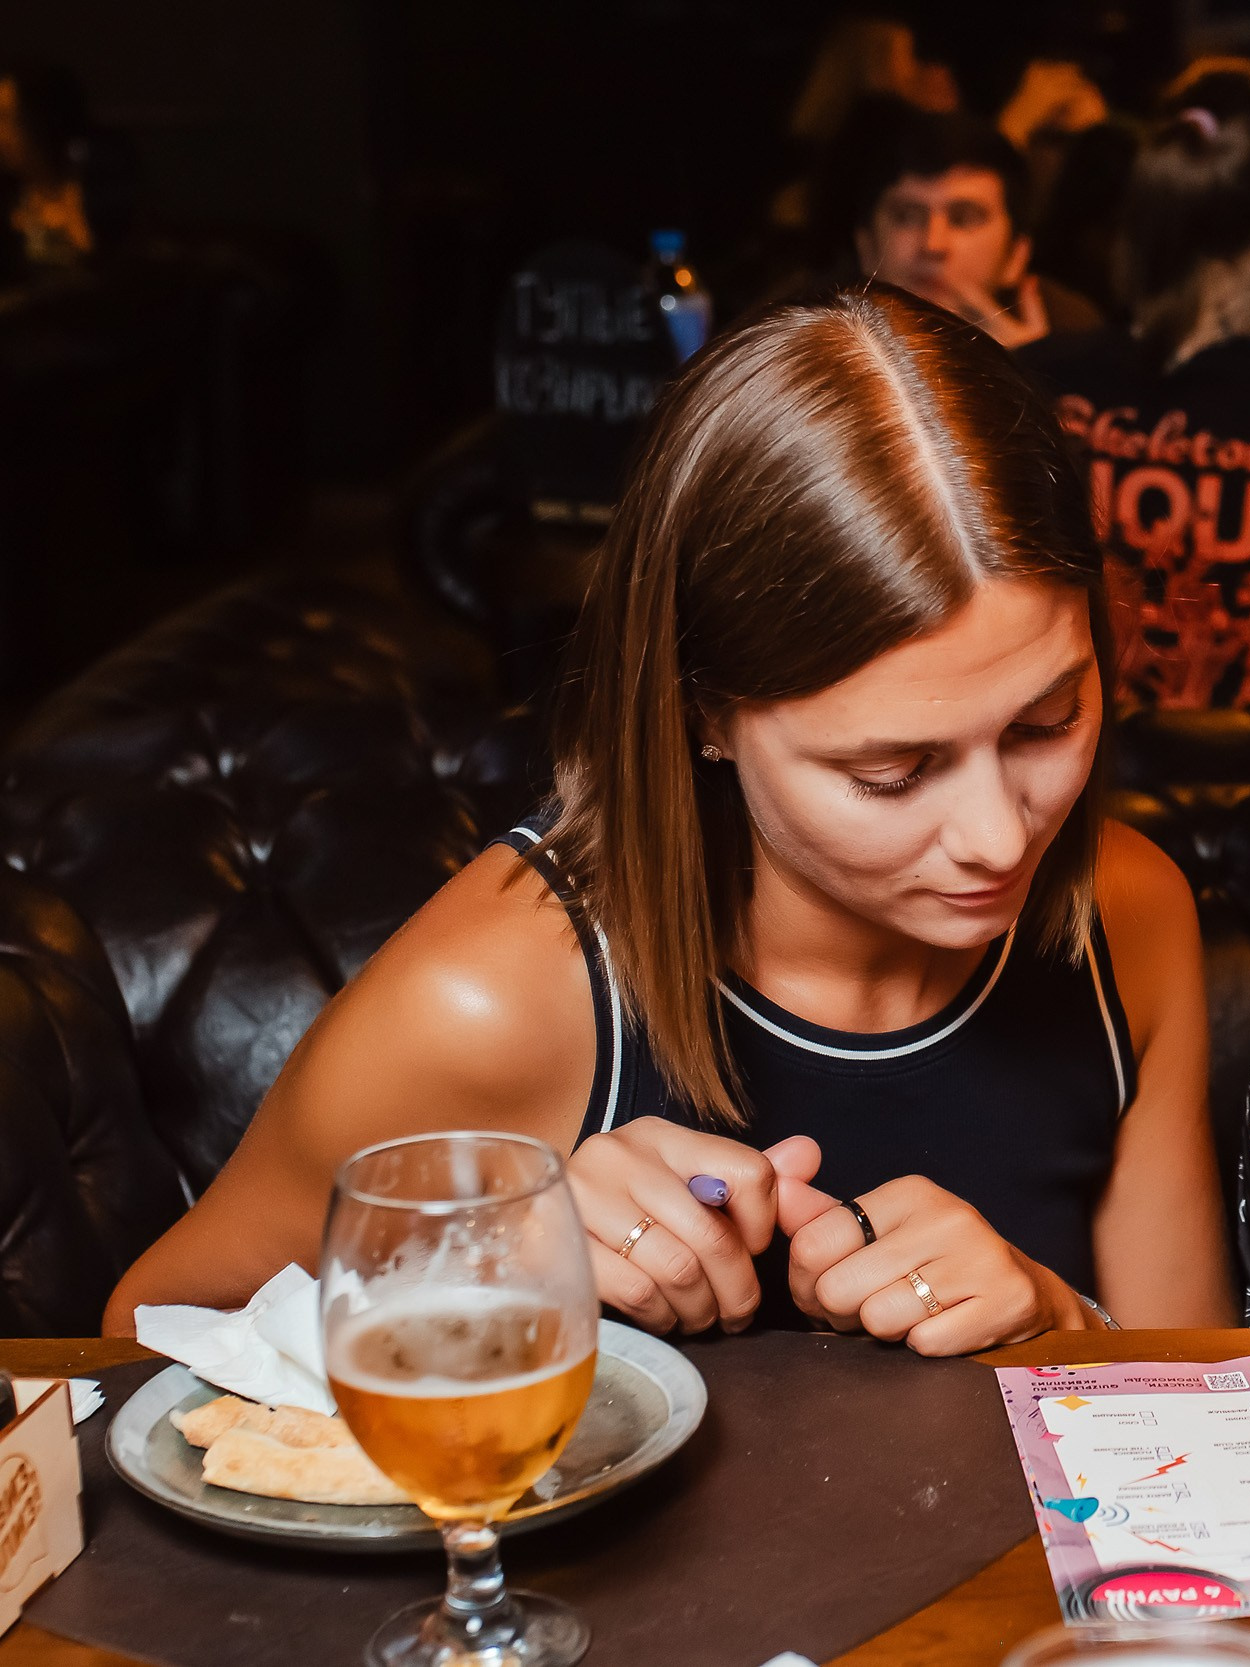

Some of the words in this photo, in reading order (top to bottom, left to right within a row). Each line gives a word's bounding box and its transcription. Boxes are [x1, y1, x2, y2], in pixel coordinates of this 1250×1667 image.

[1029, 1378, 1097, 1386] #КВИЗПЛИЗ
[1031, 1383, 1118, 1391] QUIZPLEASE.RU
[1102, 1586, 1201, 1604] РАУНД
